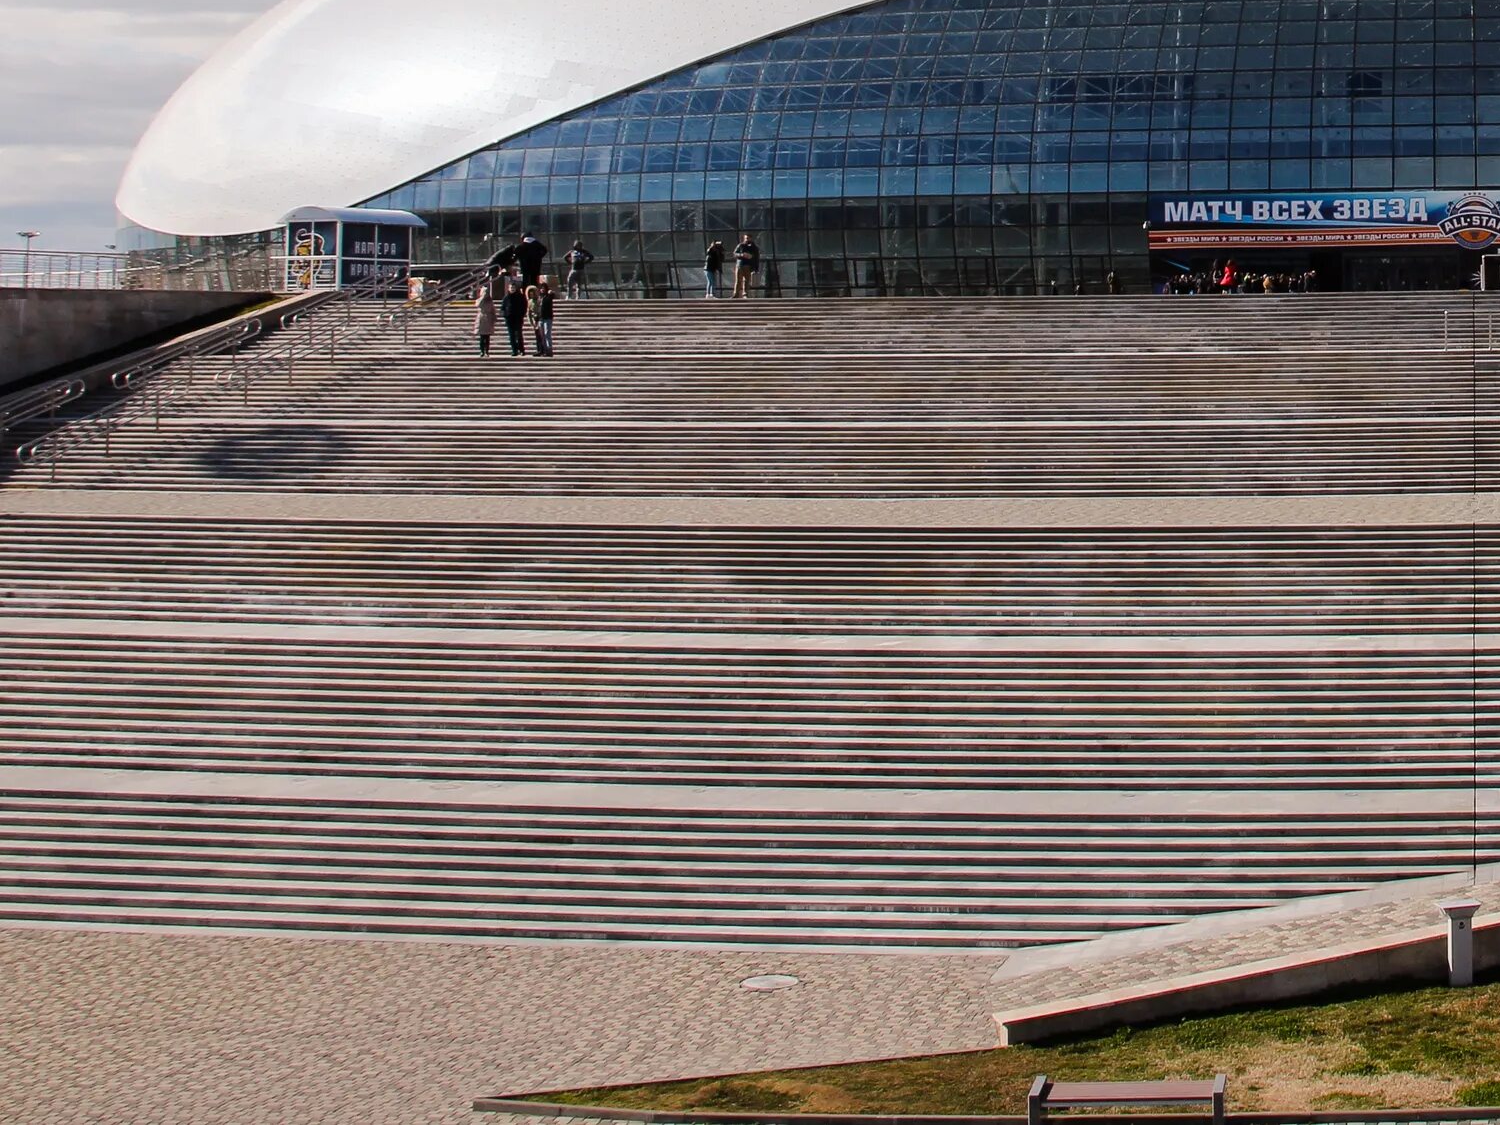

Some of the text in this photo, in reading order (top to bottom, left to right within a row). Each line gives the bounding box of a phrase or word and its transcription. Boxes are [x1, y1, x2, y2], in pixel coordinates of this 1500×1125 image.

[1164, 197, 1428, 222] МАТЧ ВСЕХ ЗВЕЗД
[1296, 235, 1324, 243] ЗВЕЗДЫ
